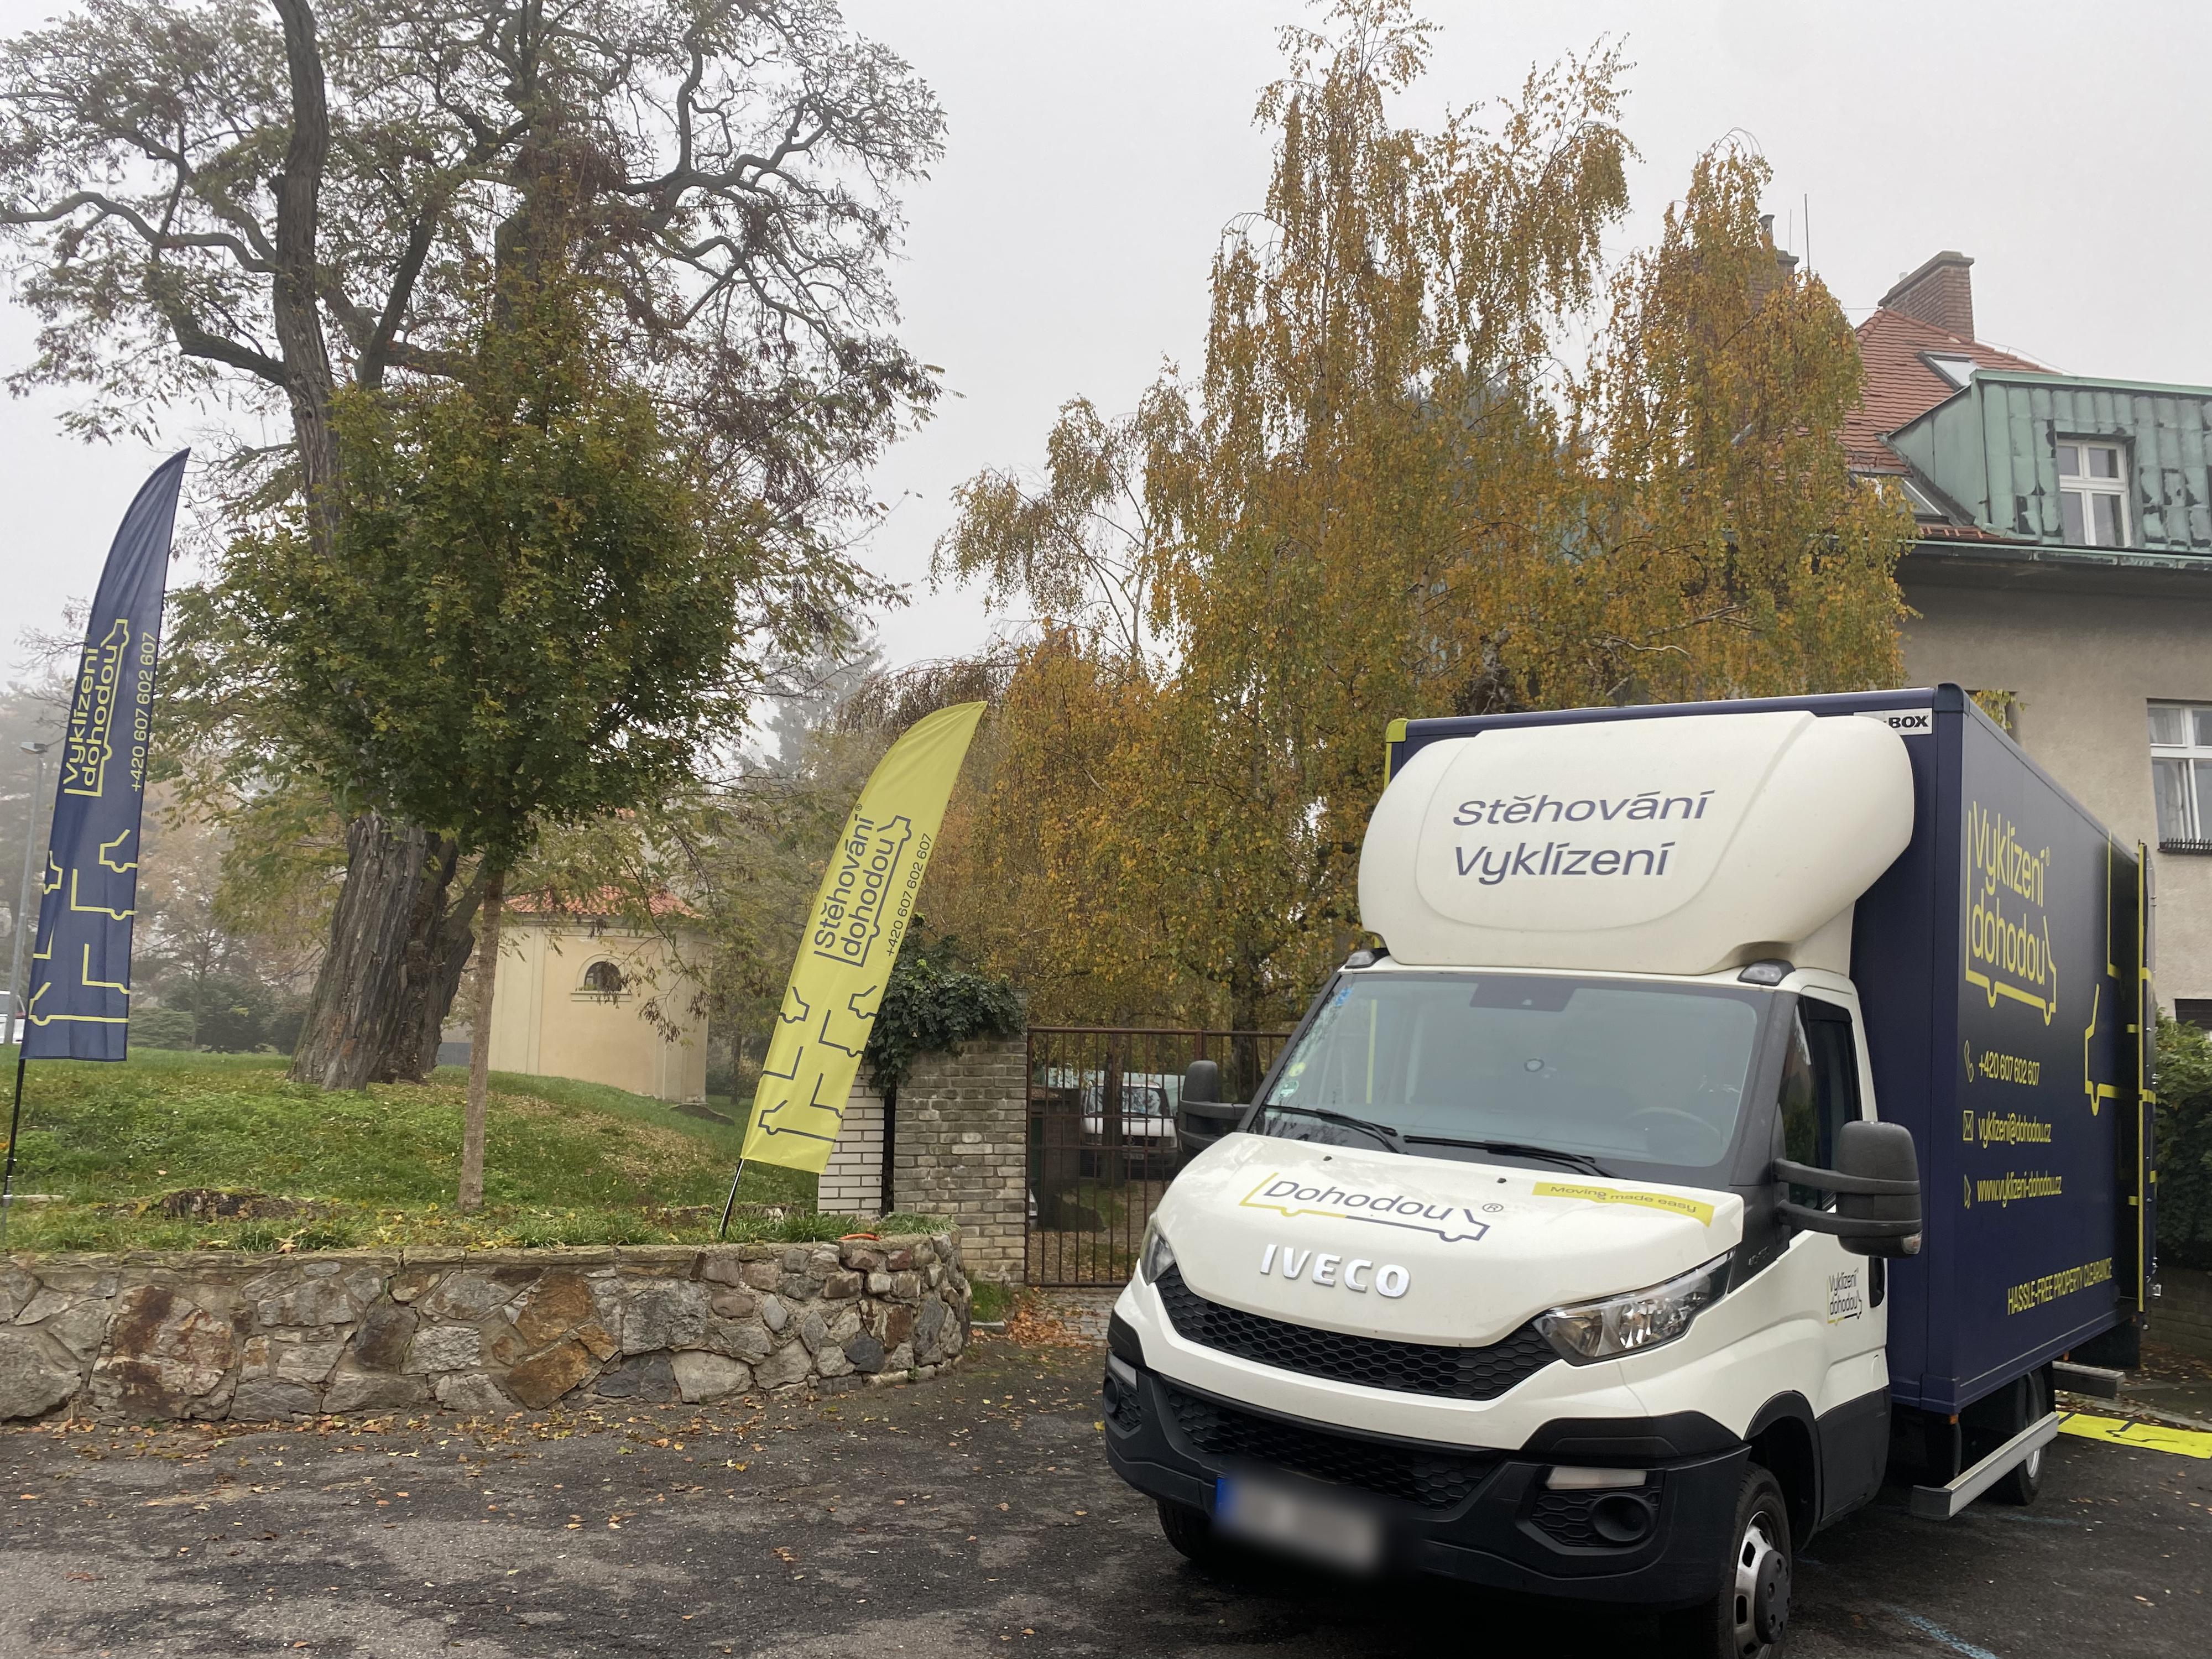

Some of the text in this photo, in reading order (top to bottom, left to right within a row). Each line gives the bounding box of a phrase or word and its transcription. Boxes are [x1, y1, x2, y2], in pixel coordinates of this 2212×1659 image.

[63, 646, 98, 785] Vyklízení
[82, 645, 118, 787] dohodou
[130, 632, 156, 792] +420 607 602 607
[1453, 790, 1715, 826] Stěhování
[1973, 800, 2046, 907] Vyklízení
[814, 813, 874, 948] Stěhování
[840, 838, 895, 957] dohodou
[886, 833, 932, 957] +420 607 602 607
[1455, 842, 1676, 885] Vyklízení
[1972, 888, 2046, 985] dohodou
[1979, 1051, 2040, 1086] +420 607 602 607
[1263, 1180, 1454, 1220] Dohodou
[1550, 1186, 1607, 1201] Moving
[1658, 1199, 1697, 1213] easy
[1260, 1244, 1411, 1299] IVECO
